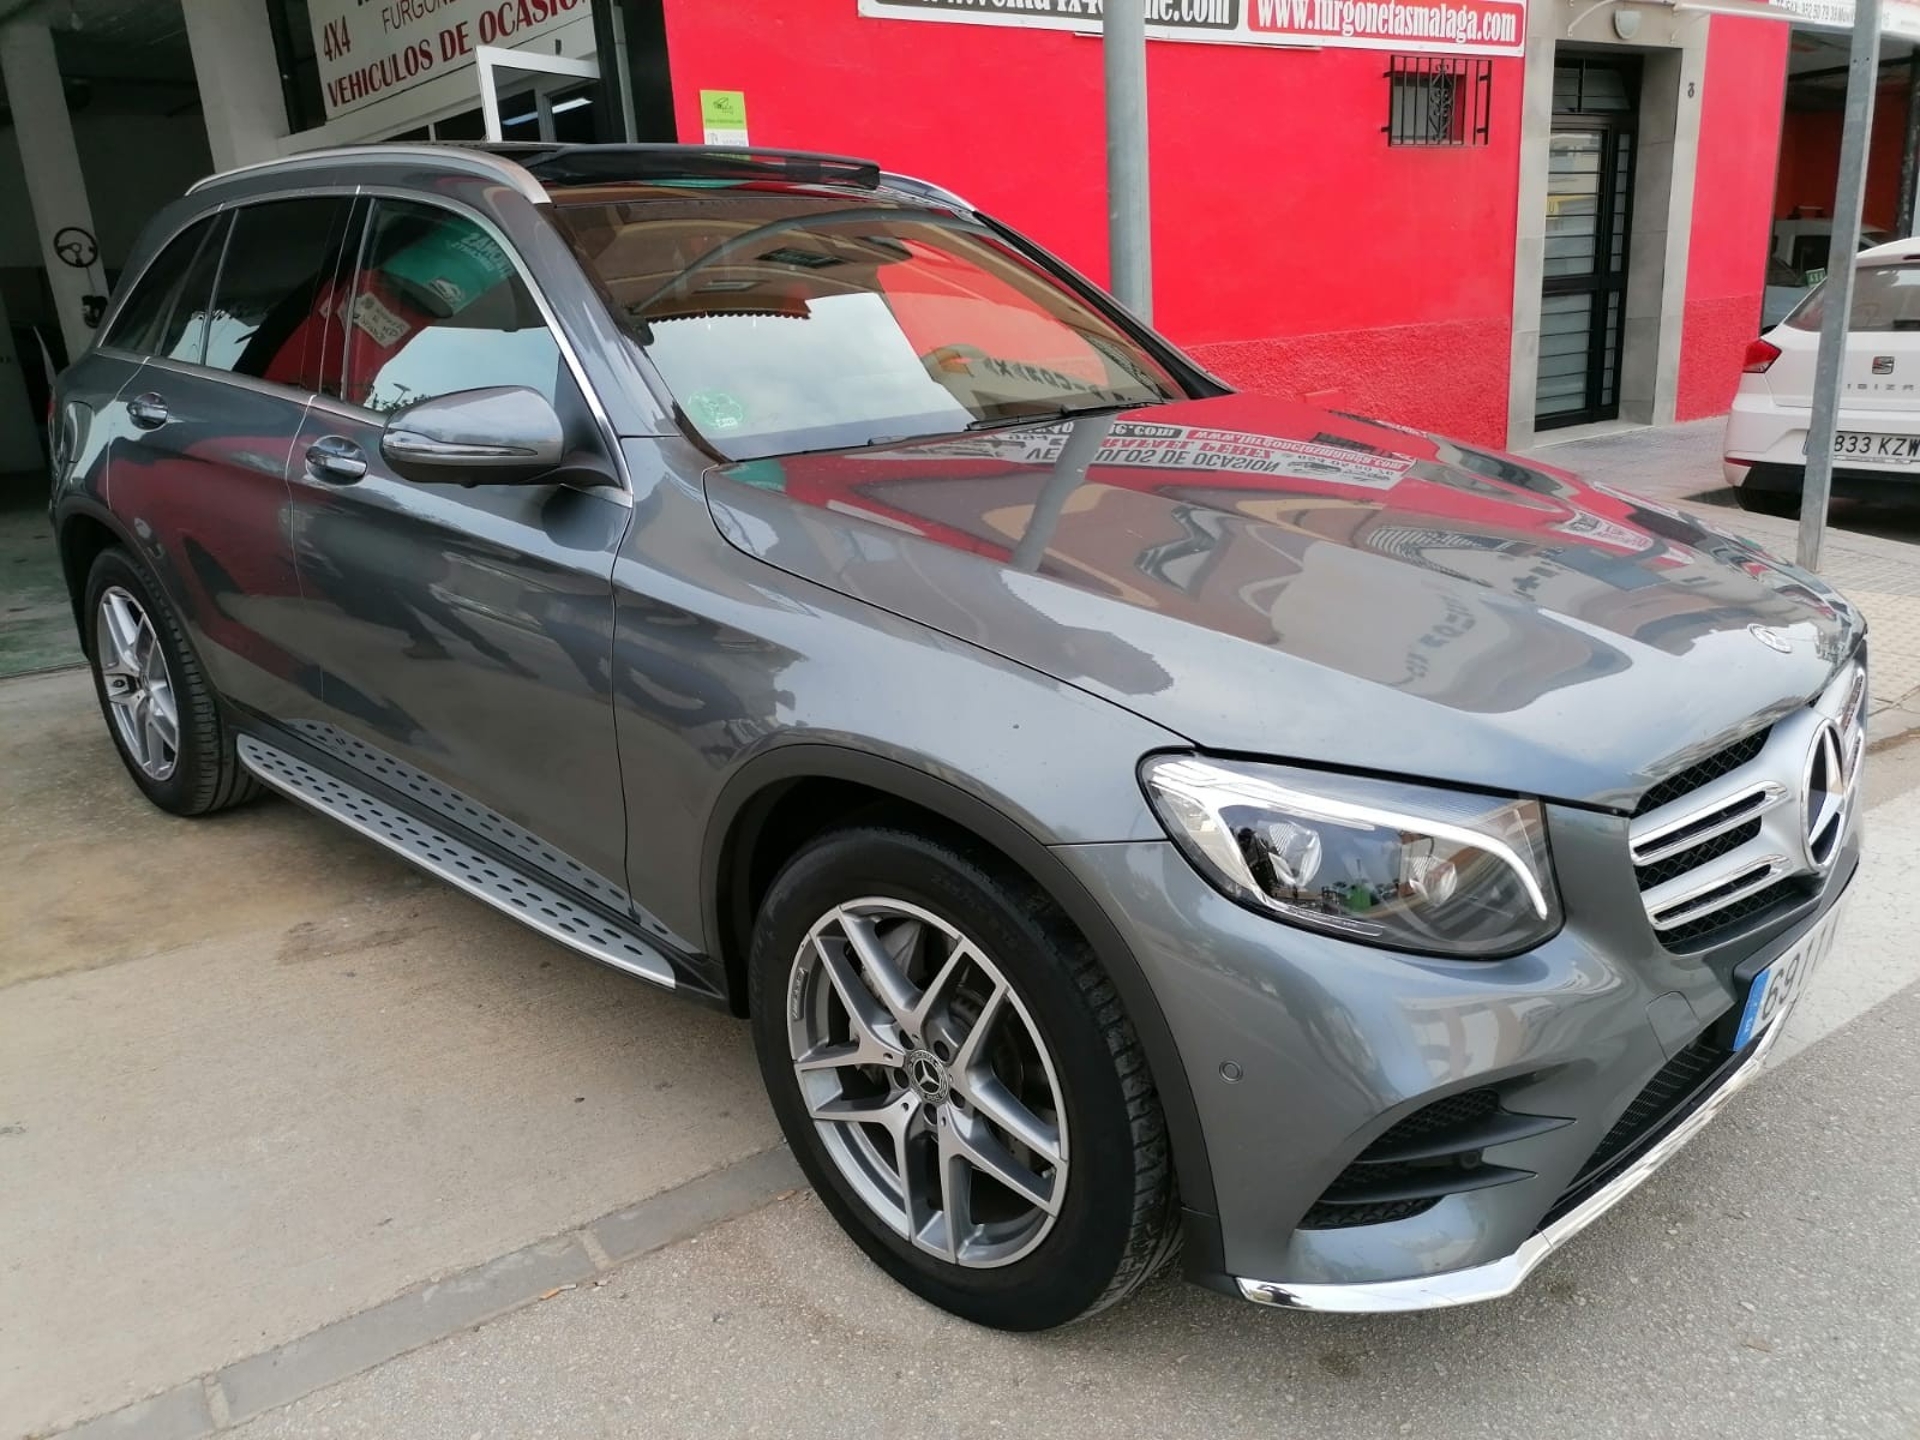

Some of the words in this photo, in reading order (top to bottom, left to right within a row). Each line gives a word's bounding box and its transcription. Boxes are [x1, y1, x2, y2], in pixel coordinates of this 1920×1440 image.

[323, 15, 351, 61] 4X4
[327, 39, 434, 107] VEHICULOS
[439, 21, 474, 62] DE
[1847, 383, 1914, 391] IBIZA
[1834, 435, 1871, 454] 833
[1878, 437, 1920, 457] KZW
